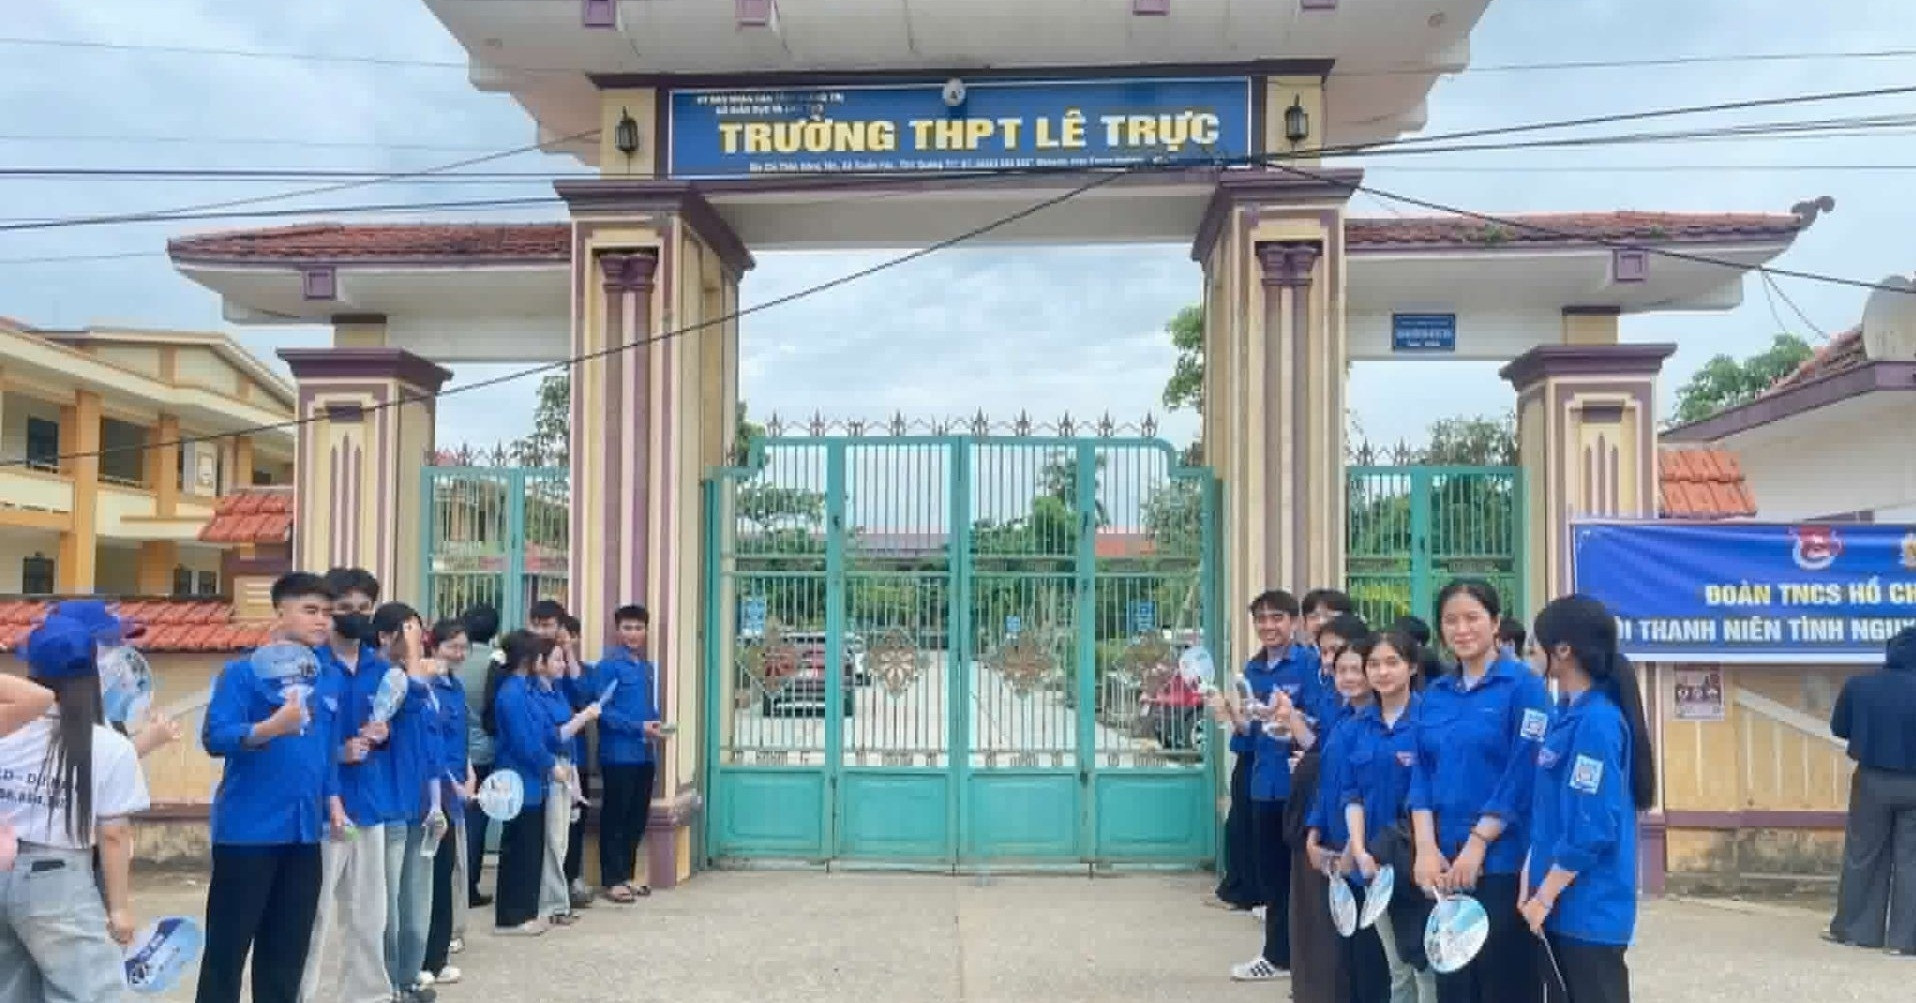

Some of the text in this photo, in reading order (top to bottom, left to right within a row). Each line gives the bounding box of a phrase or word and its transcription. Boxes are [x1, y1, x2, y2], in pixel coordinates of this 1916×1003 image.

[718, 108, 1220, 153] TRƯỜNG THPT LÊ TRỰC
[1704, 579, 1771, 606] ĐOÀN
[1778, 583, 1842, 606] TNCS
[1637, 618, 1717, 642] THANH
[1723, 615, 1782, 642] NIÊN
[1787, 615, 1844, 641] TÌNH
